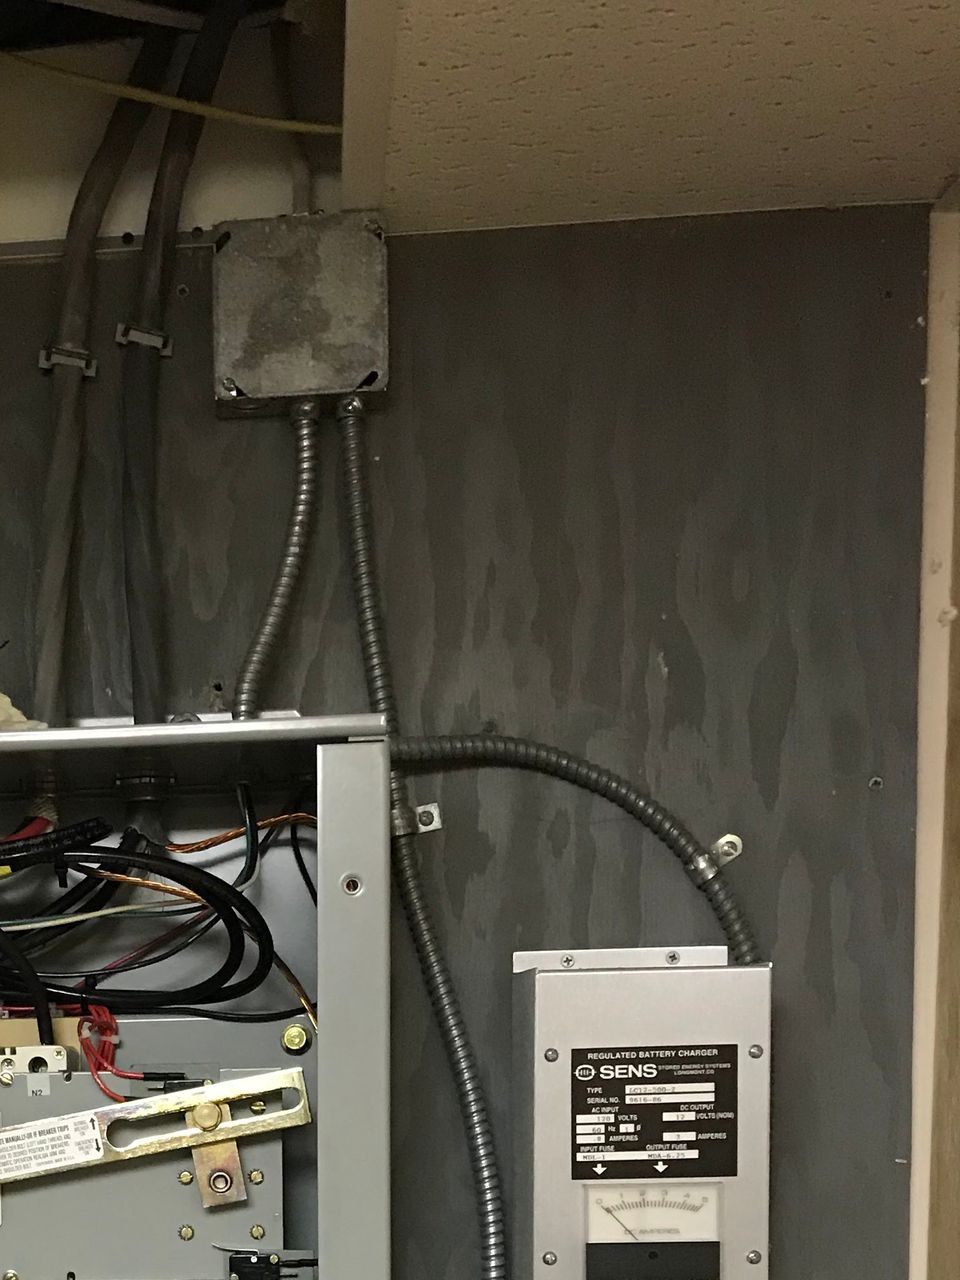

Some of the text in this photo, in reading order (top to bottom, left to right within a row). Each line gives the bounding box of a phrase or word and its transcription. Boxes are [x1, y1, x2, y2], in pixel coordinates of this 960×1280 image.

[587, 1049, 719, 1060] REGULATED BATTERY CHARGER
[599, 1063, 658, 1080] SENS
[31, 1089, 44, 1097] N2
[38, 1127, 57, 1137] BREAKER
[57, 1124, 69, 1133] TRIPS
